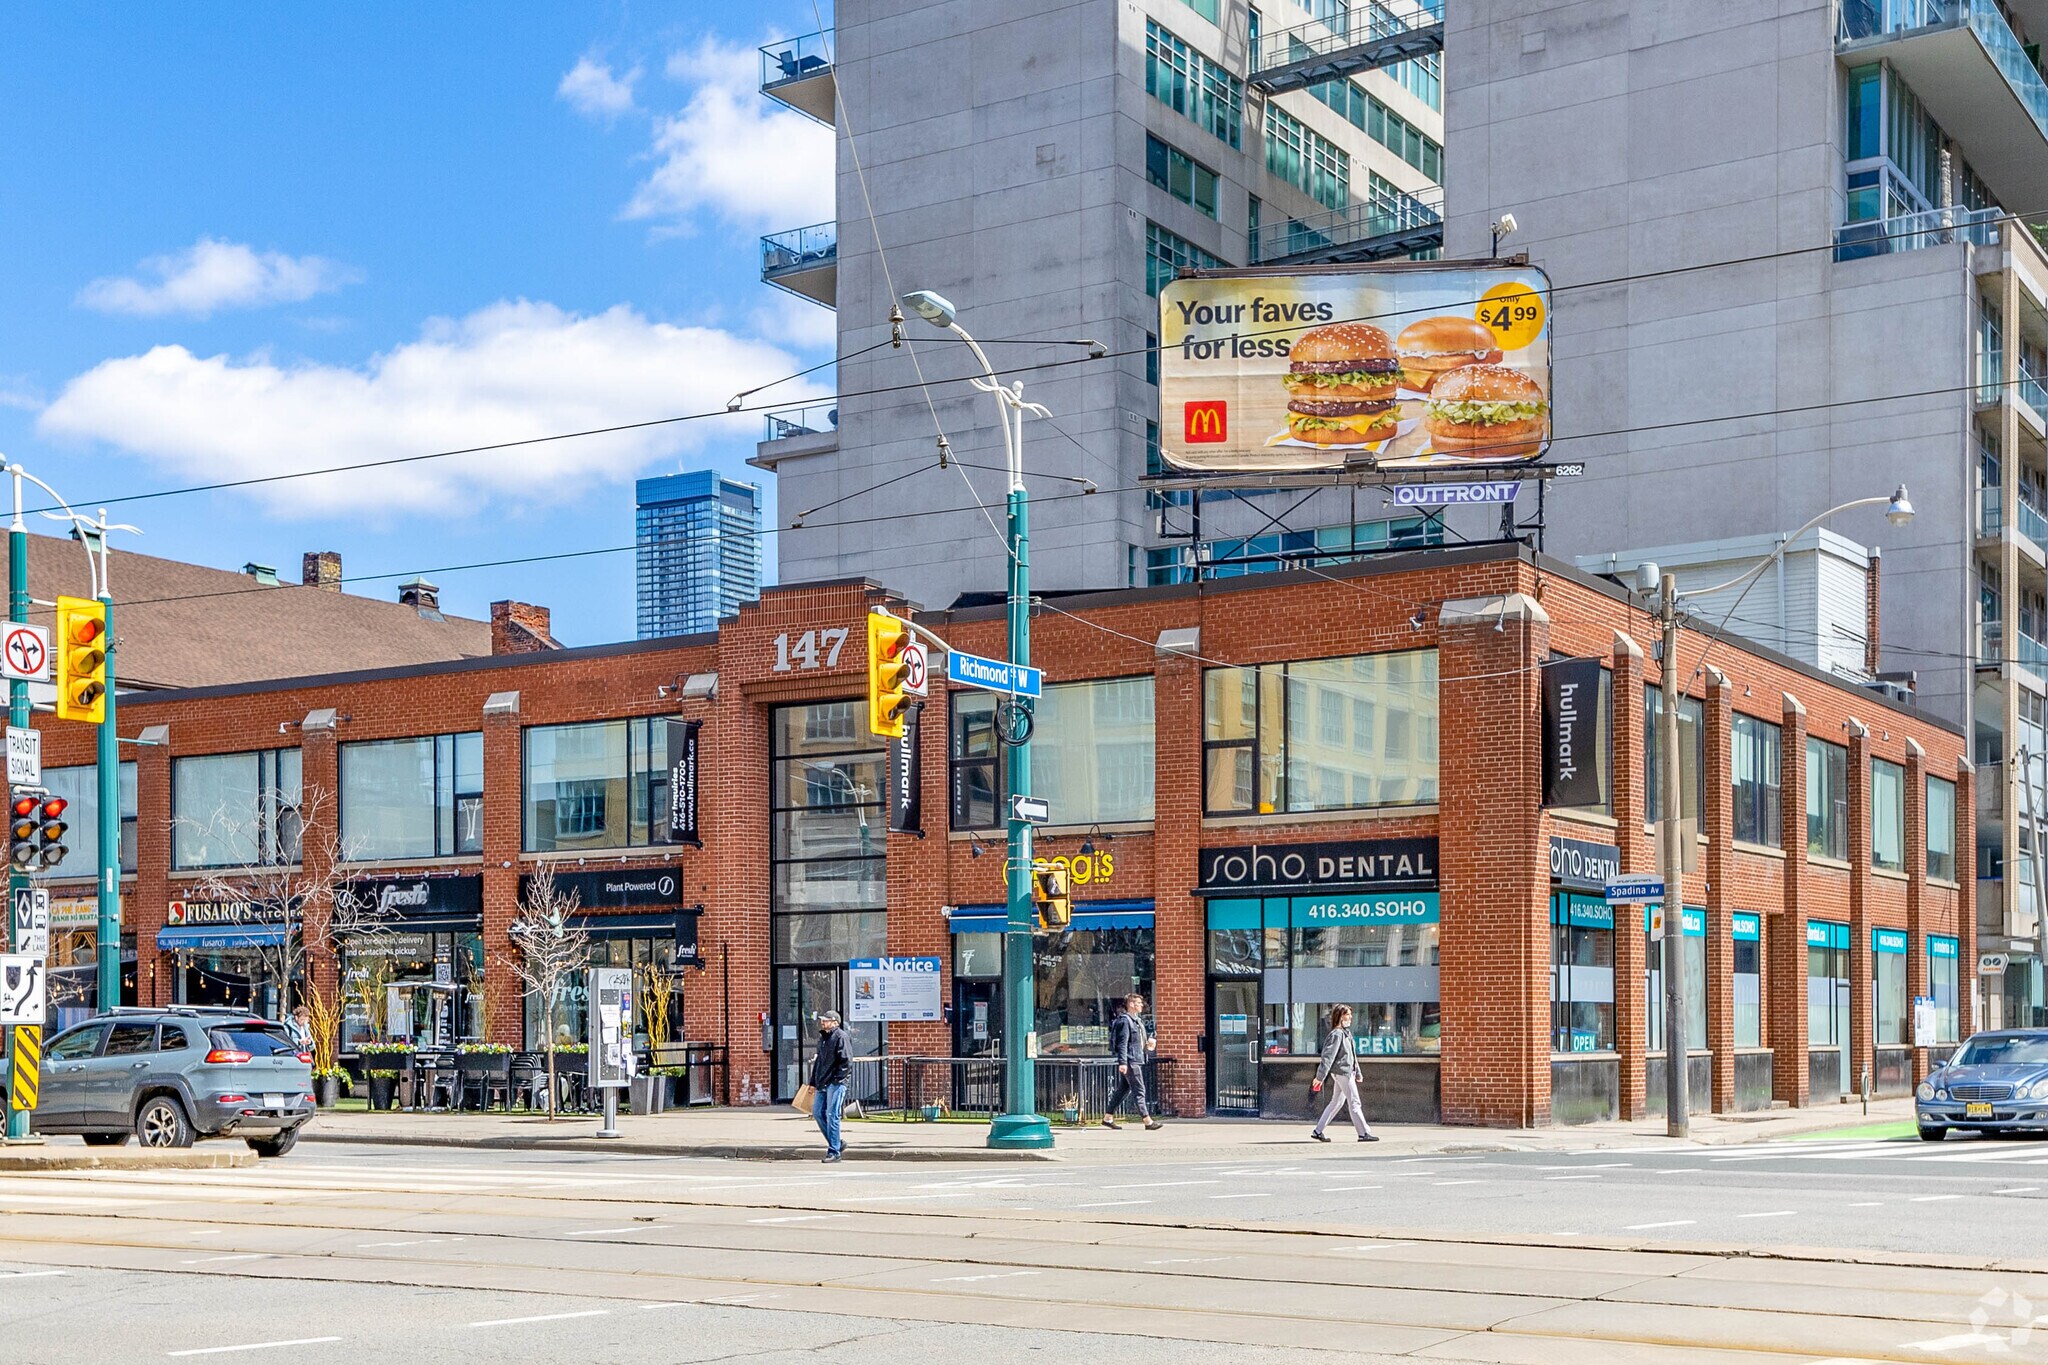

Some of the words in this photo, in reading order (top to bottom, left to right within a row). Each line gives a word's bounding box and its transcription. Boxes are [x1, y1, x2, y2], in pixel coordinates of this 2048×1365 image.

[1500, 295, 1520, 304] only
[1176, 299, 1246, 325] Your
[1251, 297, 1333, 322] faves
[1181, 334, 1225, 360] for
[1231, 333, 1291, 359] less
[1556, 465, 1583, 476] 6262
[1399, 484, 1515, 503] OUTFRONT
[773, 628, 849, 672] 147
[960, 656, 1008, 685] Richmond
[1018, 669, 1028, 688] W
[1559, 683, 1579, 781] hullmark
[9, 735, 36, 755] TRANSIT
[11, 758, 35, 776] SIGNAL
[901, 725, 911, 809] hullmark
[687, 739, 695, 831] www.hullmark.ca
[1206, 845, 1305, 883] soho
[1318, 853, 1432, 879] DENTAL
[1549, 837, 1582, 876] oho
[606, 883, 624, 892] Plant
[624, 881, 656, 891] Powered
[1611, 886, 1646, 897] Spadina
[1650, 886, 1659, 894] Av
[377, 883, 429, 914] fresh
[79, 913, 98, 921] RESTA
[187, 902, 251, 922] FUSARO'S
[254, 908, 304, 919] KITCHEN
[1308, 901, 1426, 919] 416.340.SOHO
[1570, 903, 1613, 920] 416.340.SOHO
[1683, 913, 1700, 931] ntal.ca
[33, 944, 46, 952] LANE
[34, 935, 45, 943] THIS
[364, 937, 373, 945] for
[399, 936, 424, 945] delivery
[395, 947, 417, 956] pickup
[879, 957, 934, 972] Notice
[551, 978, 589, 1009] fres
[1359, 1037, 1398, 1053] PEN
[1573, 1035, 1595, 1050] OPEN
